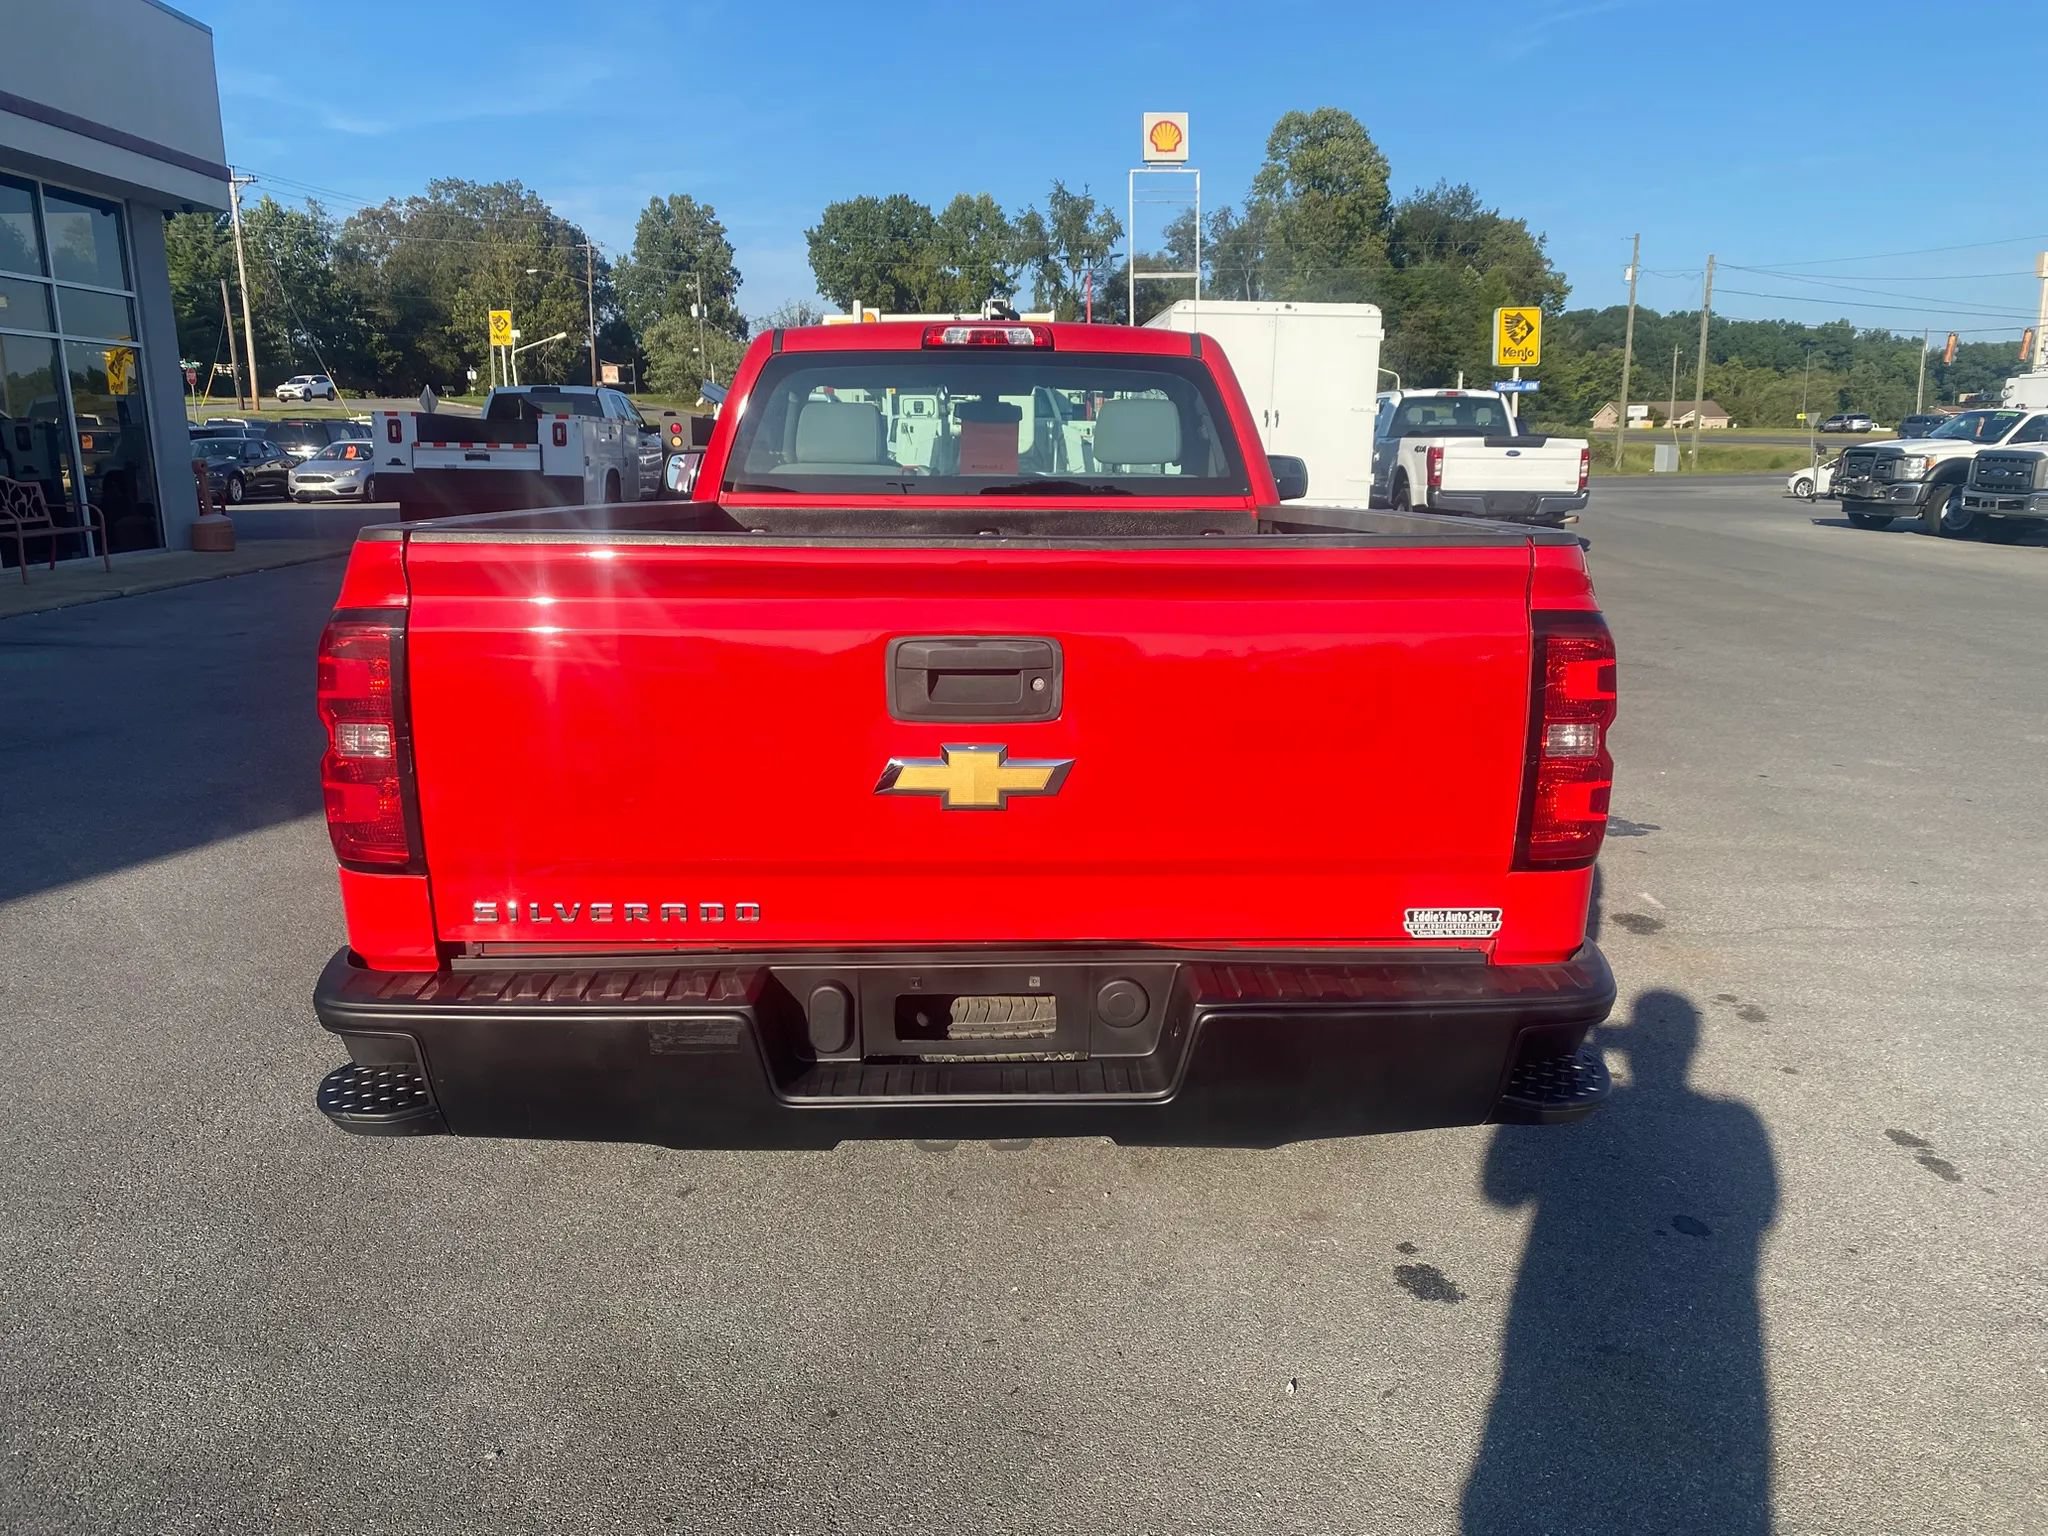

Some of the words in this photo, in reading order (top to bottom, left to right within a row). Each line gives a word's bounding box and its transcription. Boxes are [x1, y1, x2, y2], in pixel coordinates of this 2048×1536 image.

[473, 902, 760, 924] SILVERADO
[1413, 911, 1445, 922] Eddie's
[1446, 911, 1468, 922] Auto
[1468, 911, 1493, 922] Sales
